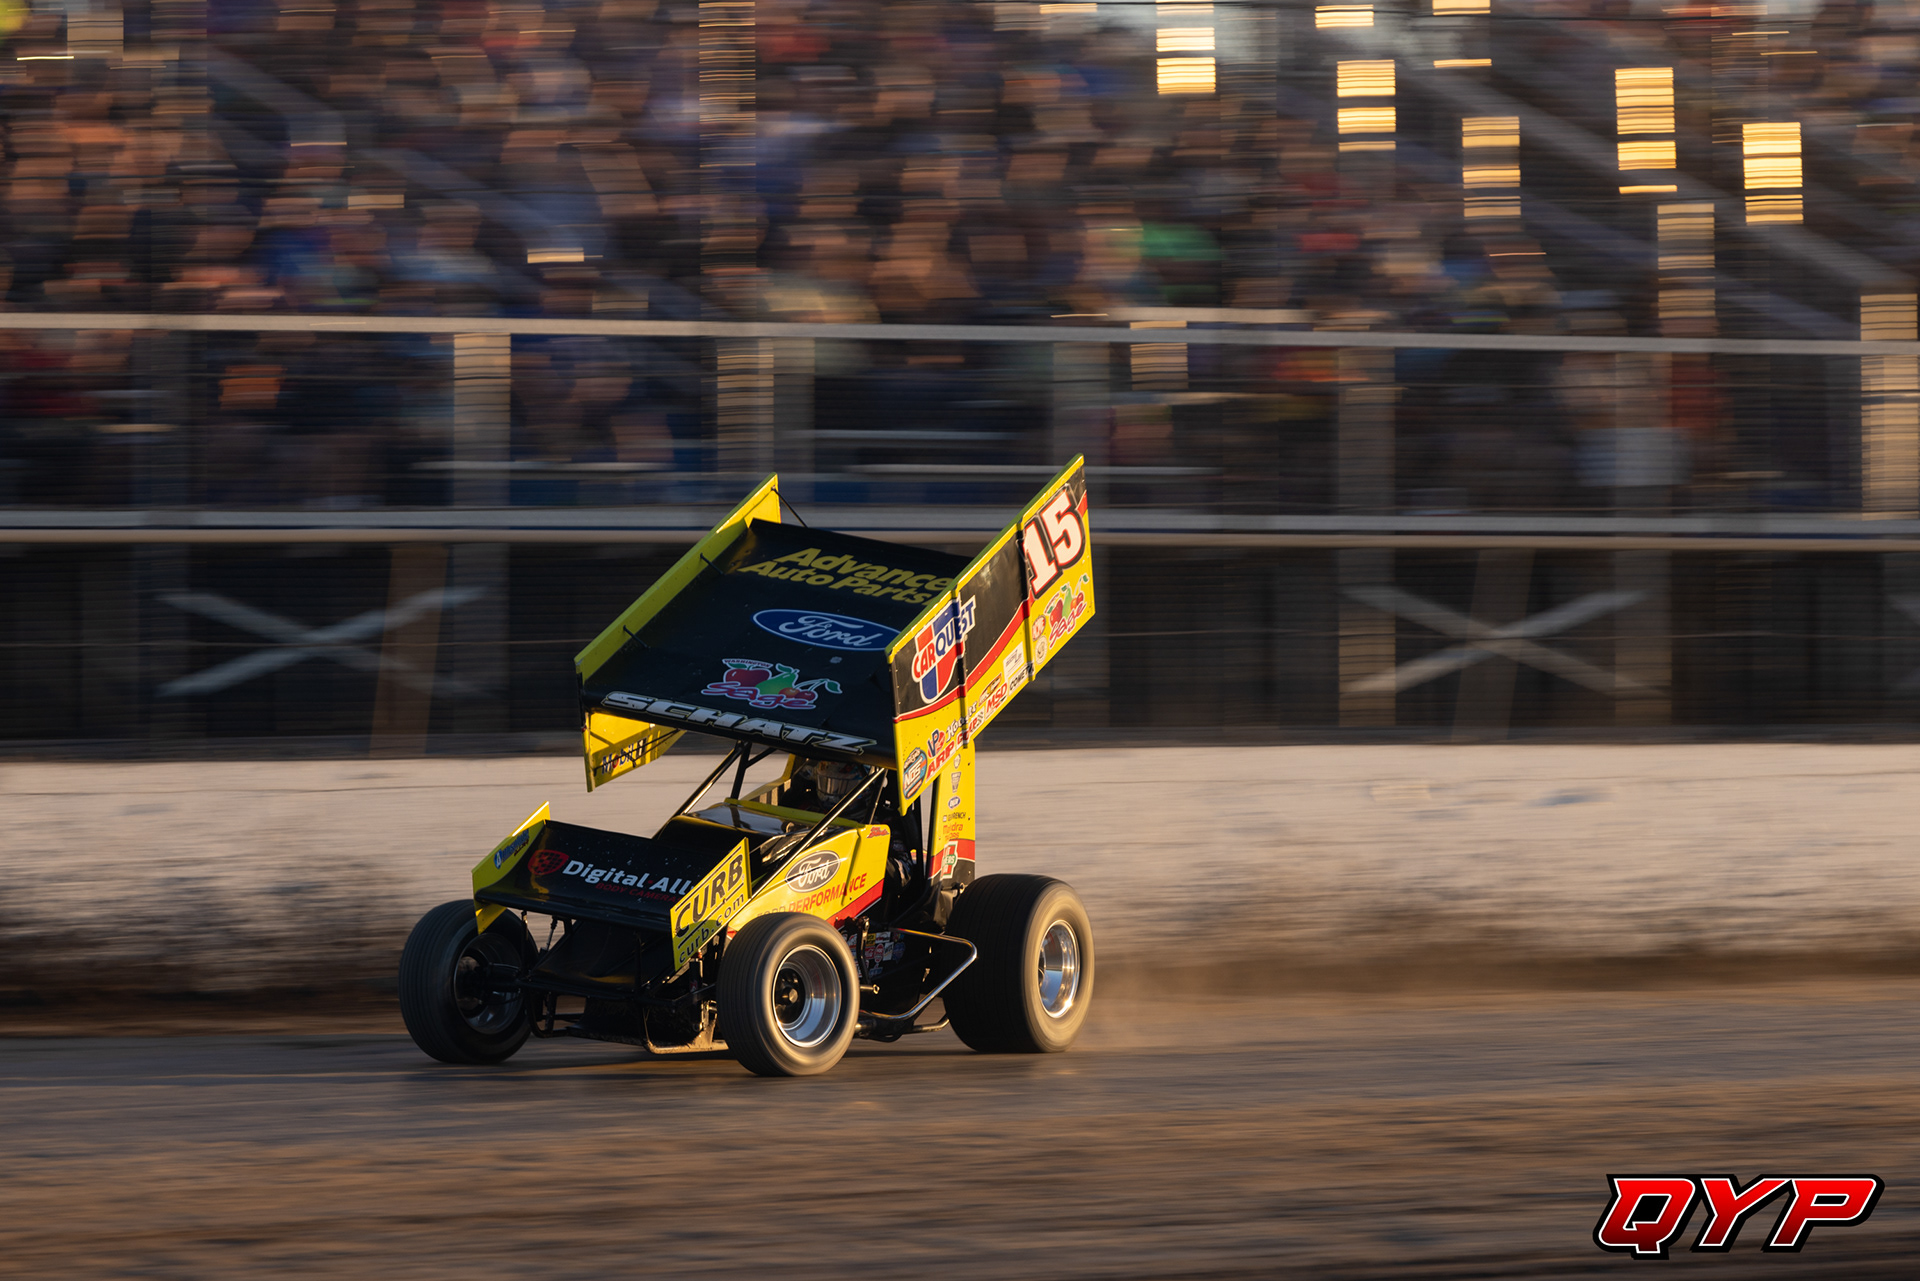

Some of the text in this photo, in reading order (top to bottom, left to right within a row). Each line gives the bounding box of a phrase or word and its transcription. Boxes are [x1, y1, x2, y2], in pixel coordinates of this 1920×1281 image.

[1020, 488, 1085, 597] 15
[737, 560, 835, 586] Auto
[773, 547, 954, 593] Advance
[779, 615, 883, 647] Ford
[986, 682, 1008, 713] MSD
[602, 691, 877, 755] SCHATZ
[926, 741, 955, 780] ARP
[562, 860, 695, 896] Digital All
[595, 882, 626, 895] BODY
[797, 857, 831, 888] Ford
[675, 854, 744, 938] CURB
[788, 872, 868, 913] PERFORMANCE
[679, 893, 744, 964] curb.com
